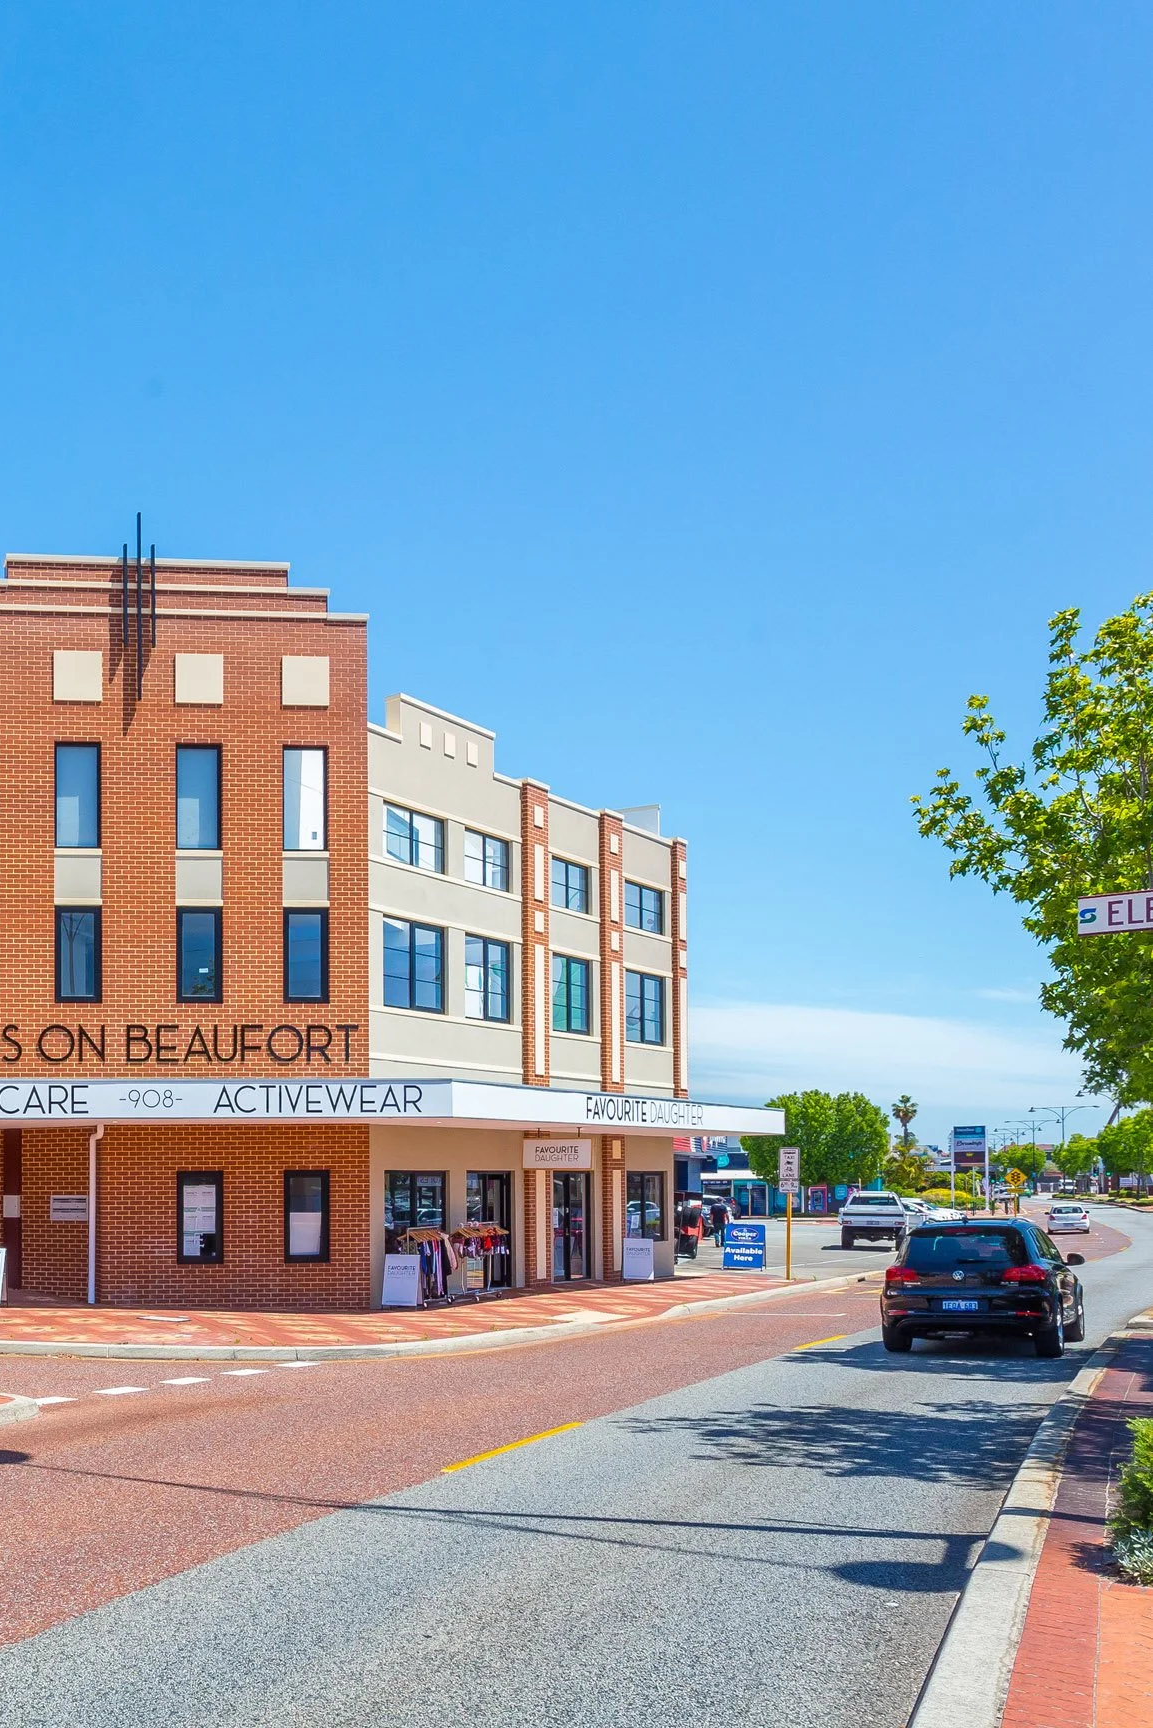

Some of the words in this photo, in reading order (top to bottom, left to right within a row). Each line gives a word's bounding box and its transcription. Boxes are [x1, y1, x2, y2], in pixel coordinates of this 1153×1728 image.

[37, 1024, 106, 1064] ON
[125, 1024, 359, 1064] BEAUFORT
[213, 1084, 423, 1114] ACTIVEWEAR
[586, 1096, 647, 1123] FAVOURITE
[650, 1101, 704, 1126] DAUGHTER
[535, 1145, 579, 1154] FAVOURITE
[534, 1153, 579, 1162] DAUGHTER
[732, 1230, 758, 1238] Cooper
[724, 1246, 763, 1255] Available
[733, 1254, 754, 1262] Here
